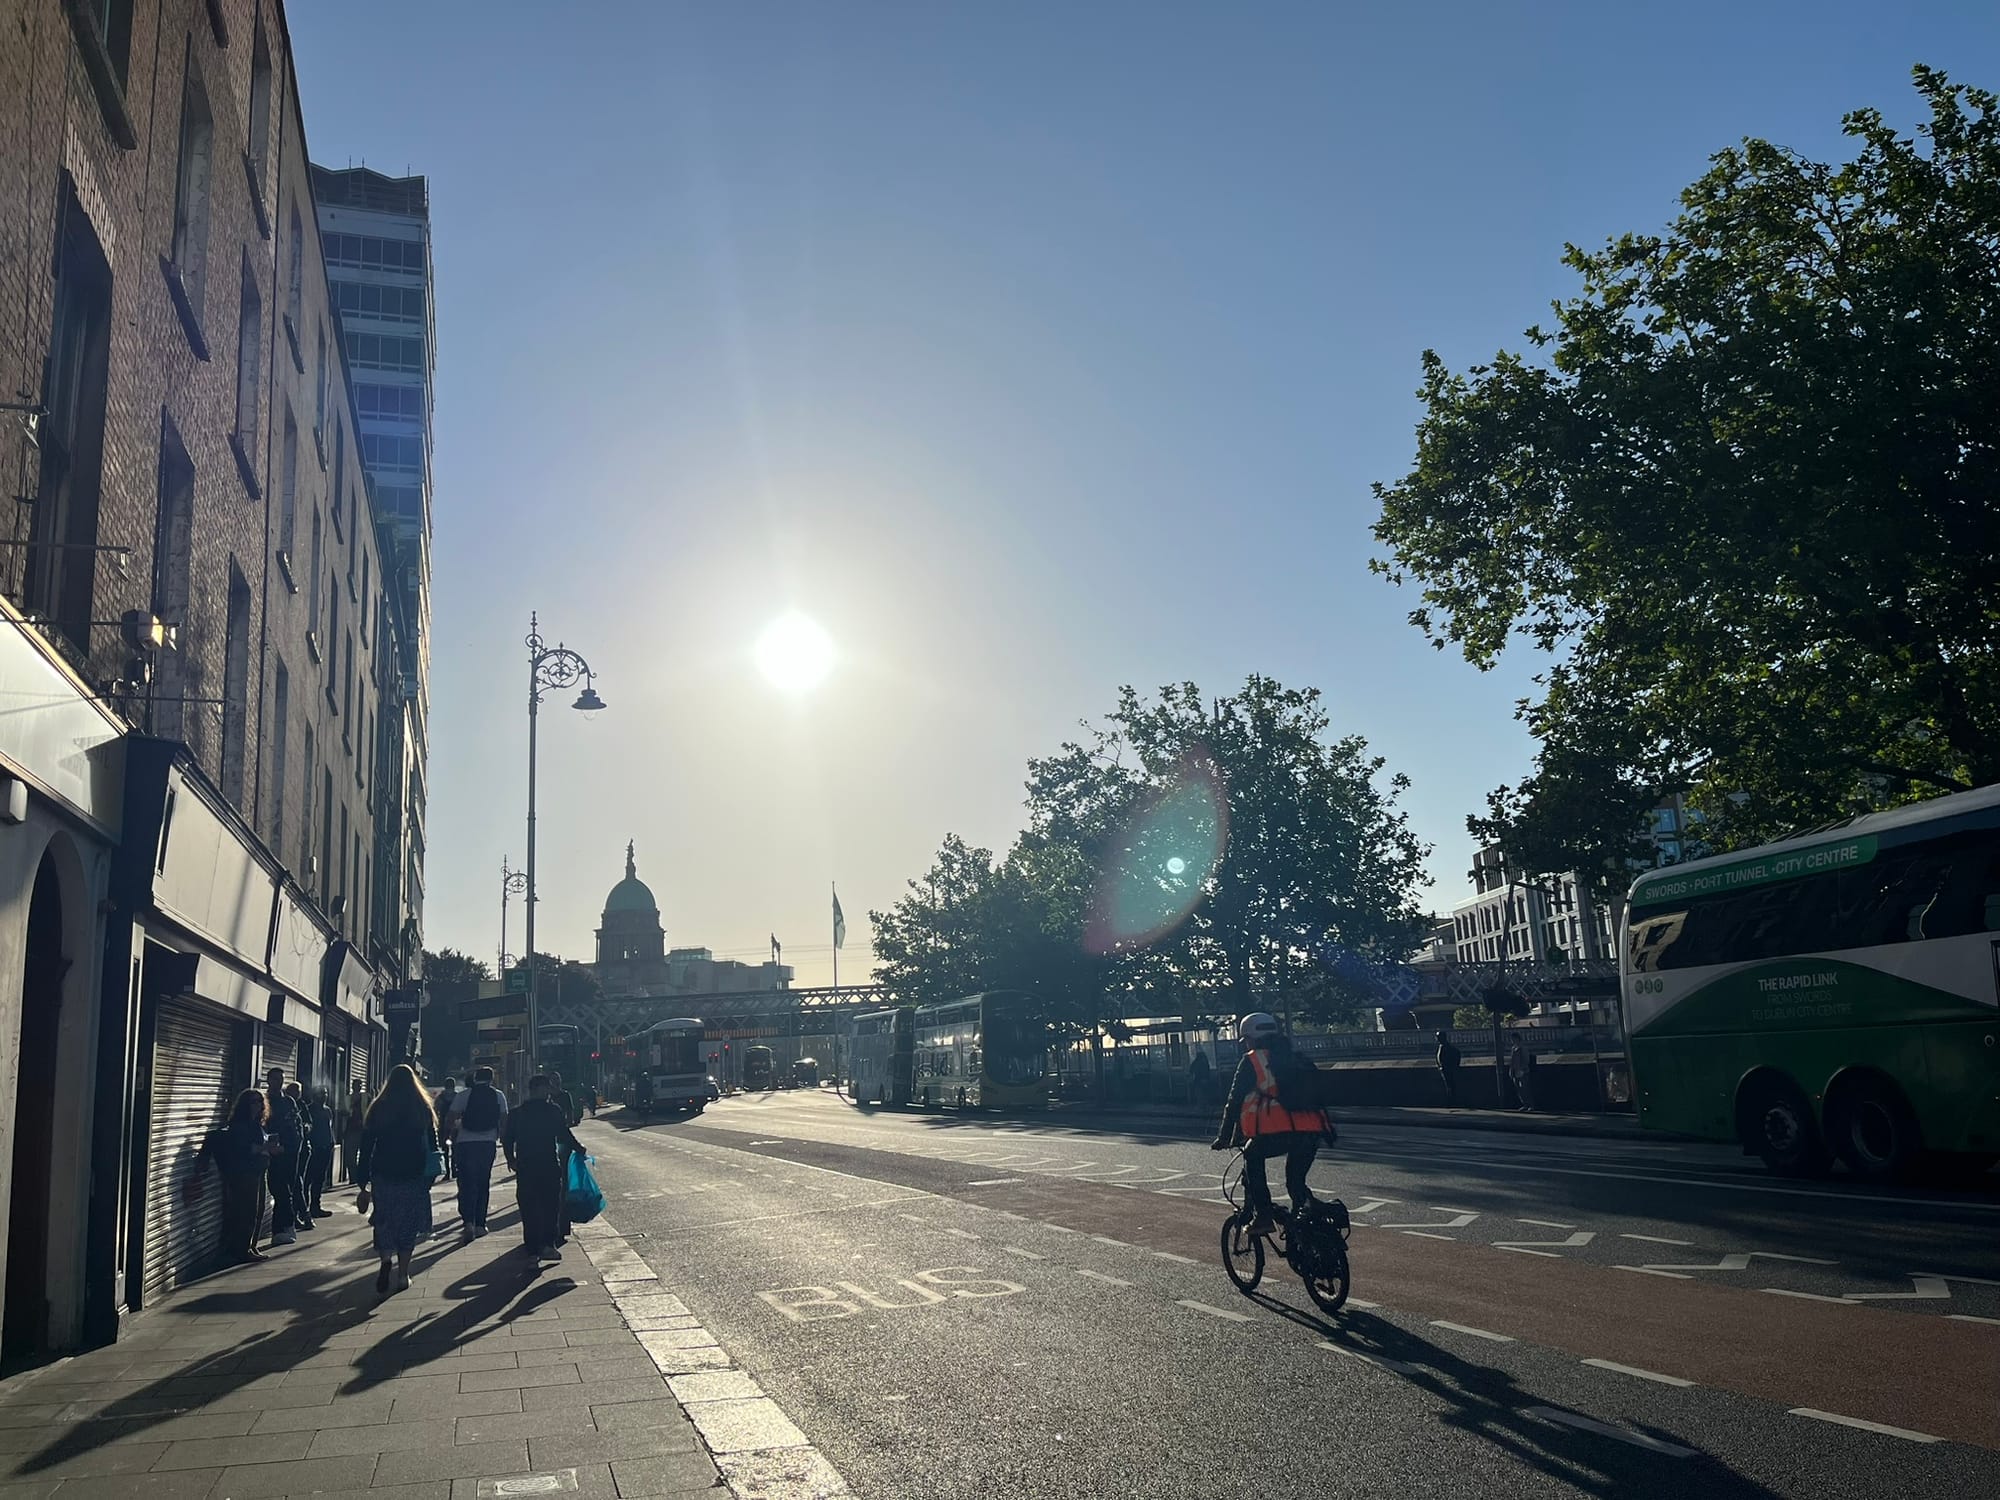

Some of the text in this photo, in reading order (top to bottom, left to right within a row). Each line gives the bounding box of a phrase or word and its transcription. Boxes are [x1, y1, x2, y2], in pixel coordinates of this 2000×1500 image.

[1645, 845, 1859, 900] SWORDS PORT TUNNEL CITY CENTRE
[1757, 971, 1839, 992] THE RAPID LINK
[754, 1265, 1027, 1323] BUS
